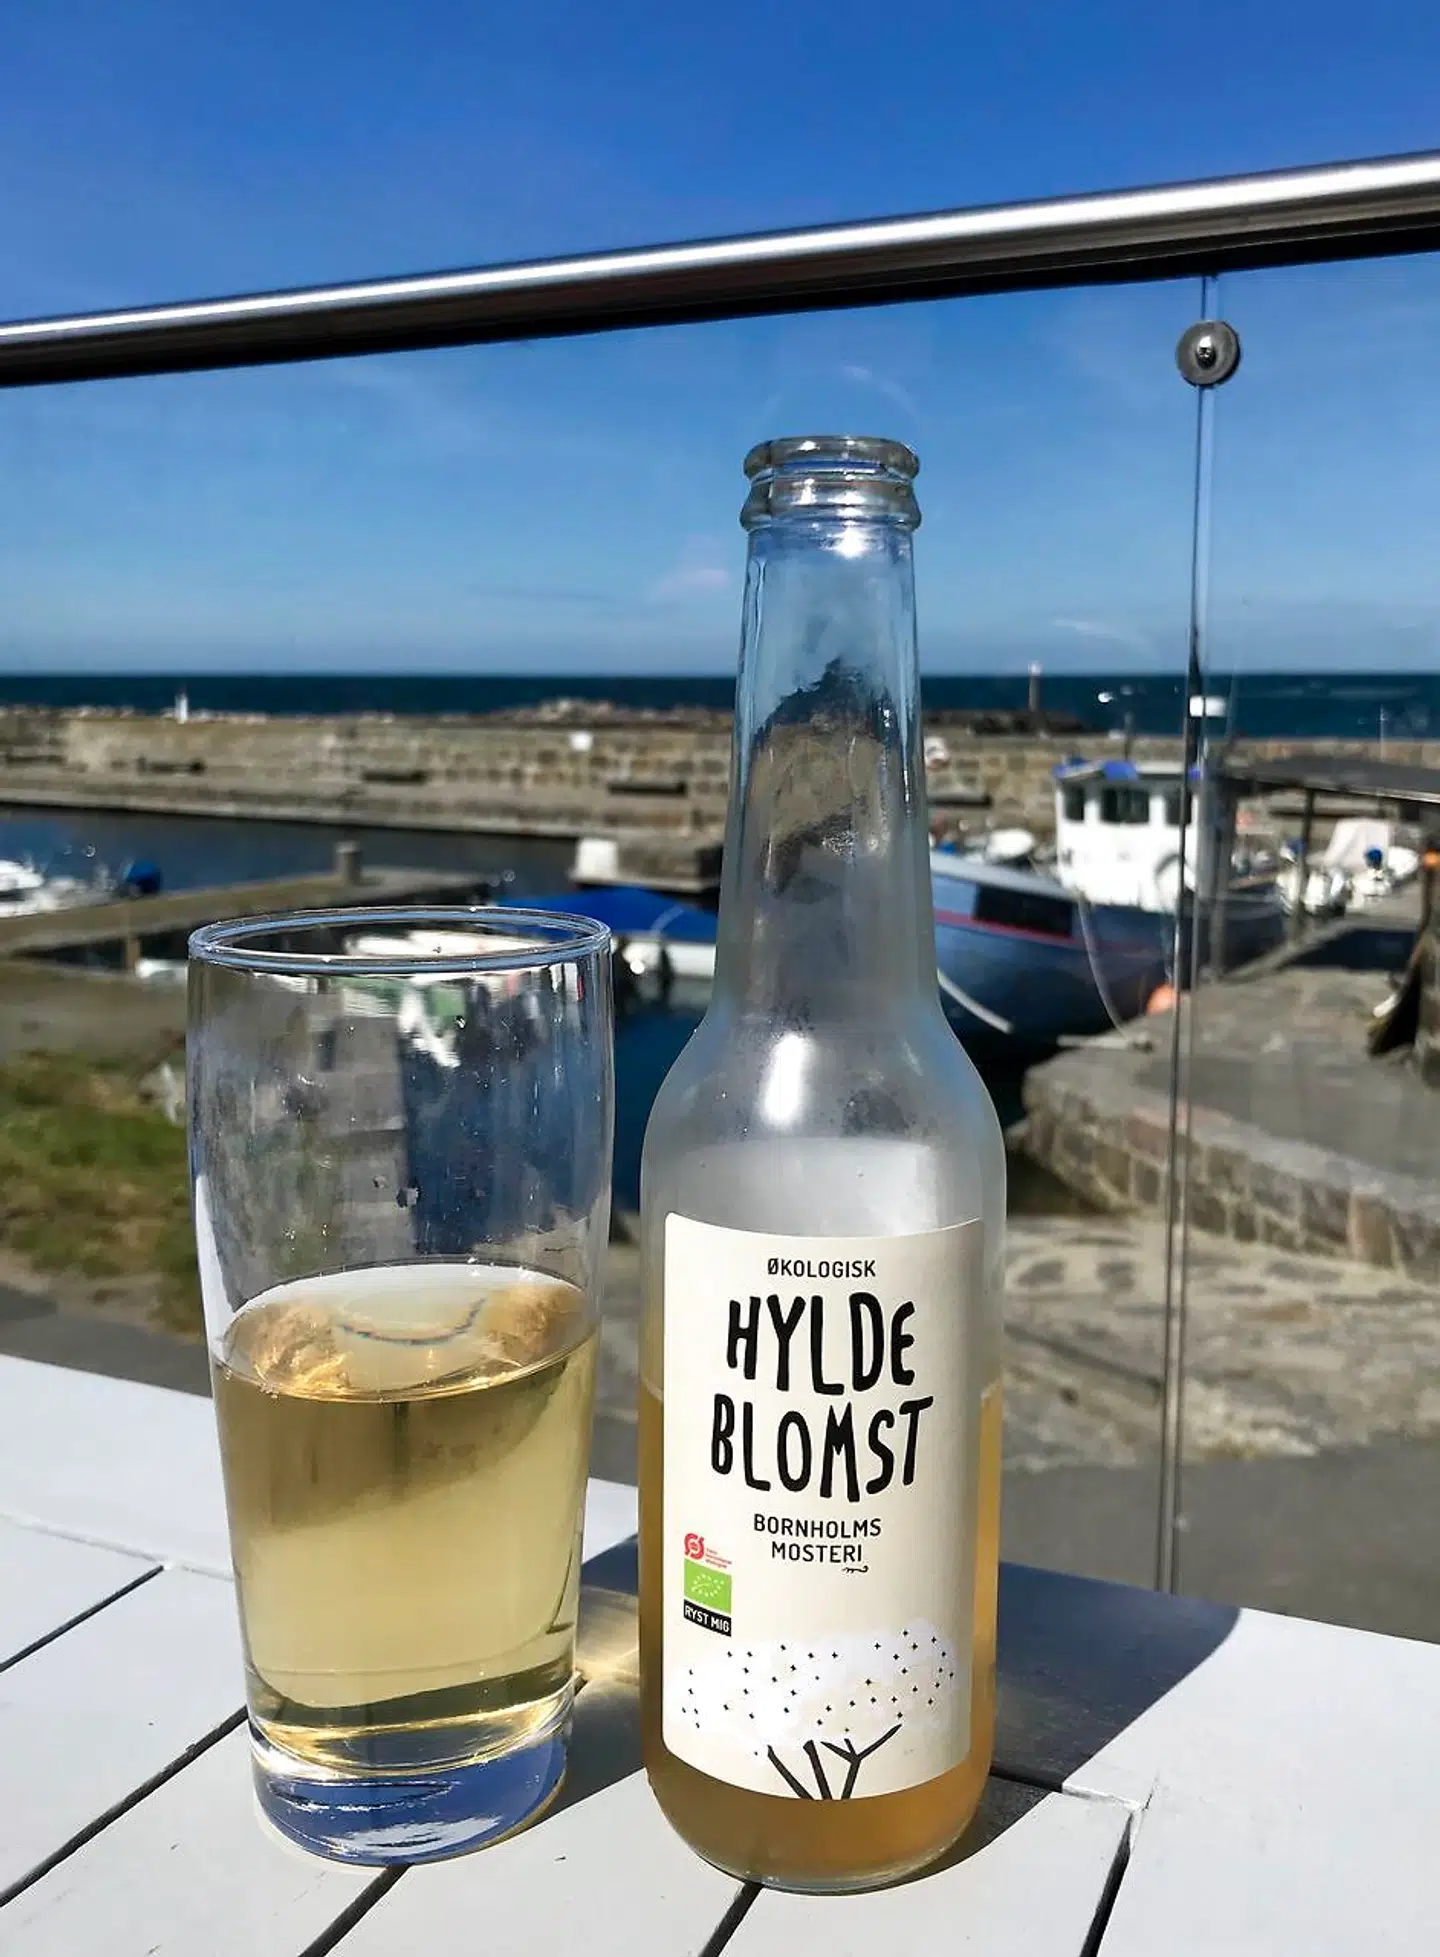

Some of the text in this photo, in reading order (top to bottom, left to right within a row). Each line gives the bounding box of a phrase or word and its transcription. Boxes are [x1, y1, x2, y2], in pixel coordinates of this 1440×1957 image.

[767, 1258, 876, 1278] ØKOLOGISK
[727, 1292, 915, 1395] HYLDE
[711, 1393, 934, 1502] BLOMST
[753, 1514, 882, 1539] BORNHOLMS
[771, 1542, 862, 1563] MOSTERI
[684, 1605, 730, 1633] RYST MIG
